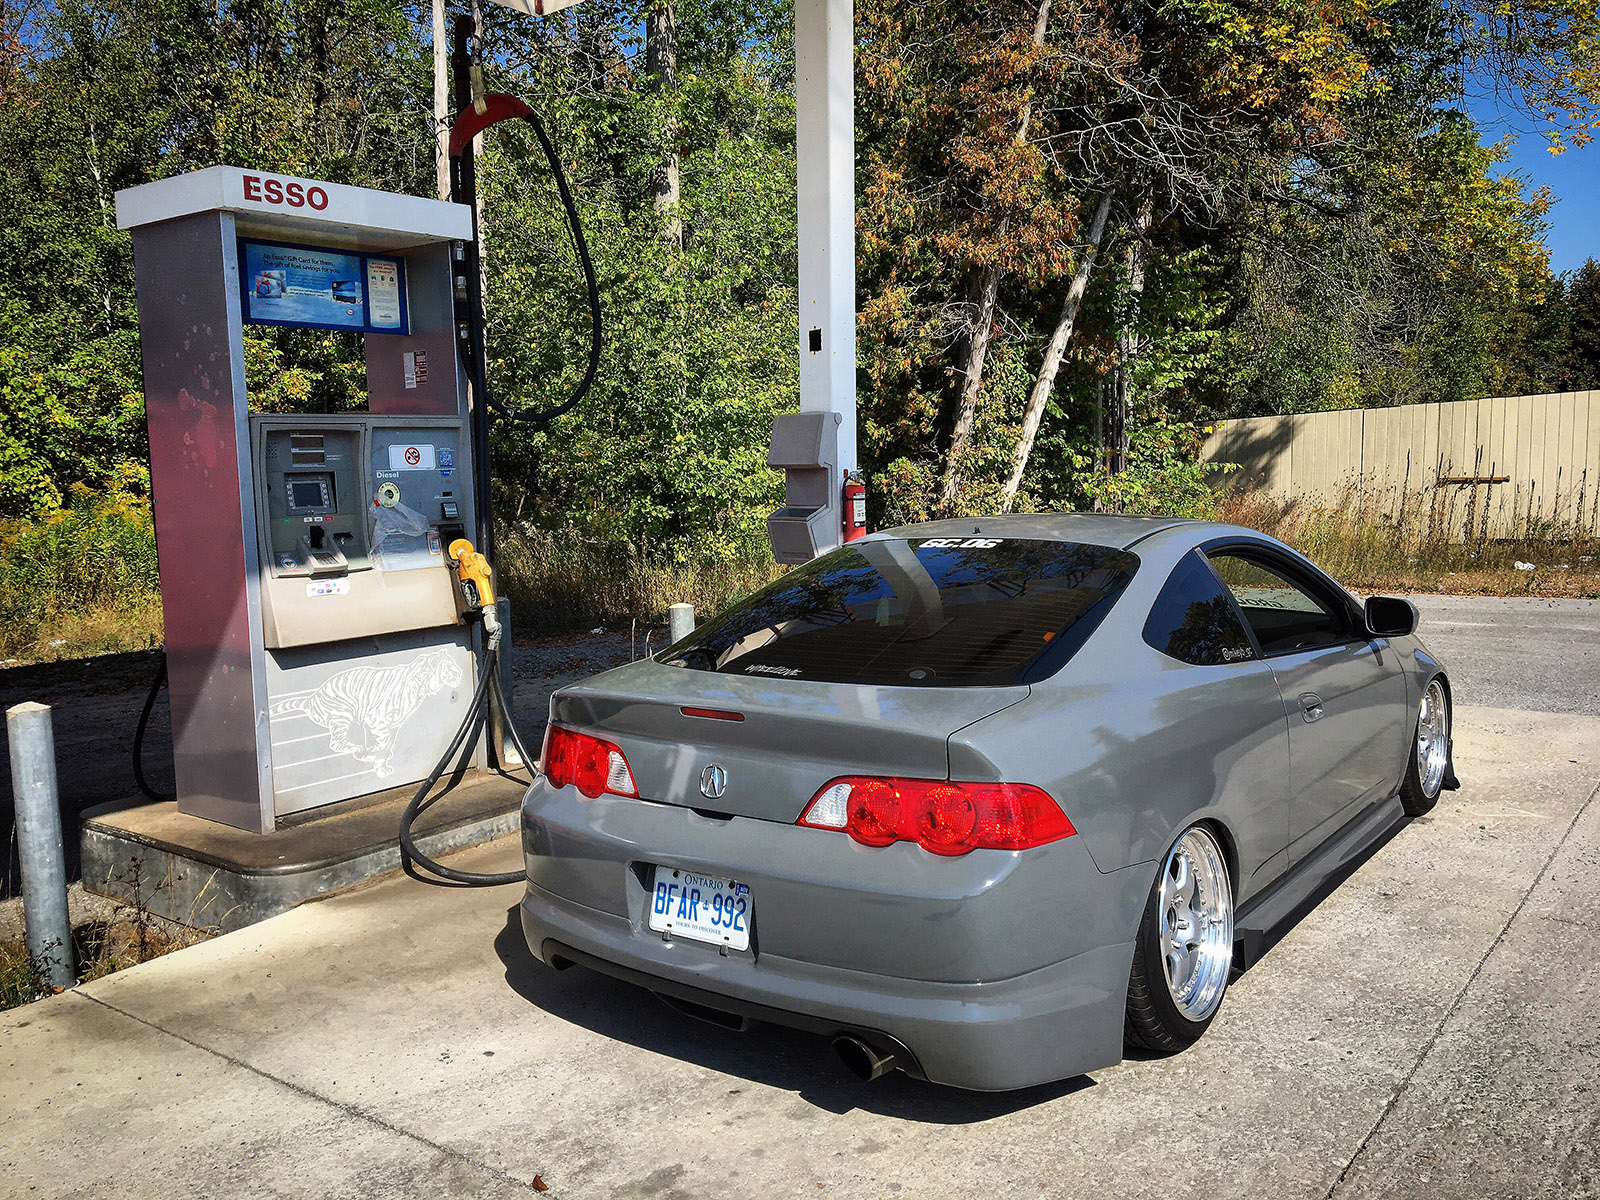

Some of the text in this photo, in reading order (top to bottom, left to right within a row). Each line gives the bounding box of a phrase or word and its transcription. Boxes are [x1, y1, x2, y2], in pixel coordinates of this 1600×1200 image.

[242, 174, 329, 211] ESSO
[376, 471, 400, 479] Diesel
[684, 873, 724, 890] ONTARIO
[675, 920, 690, 928] YOURS
[698, 924, 722, 935] DISCOVER
